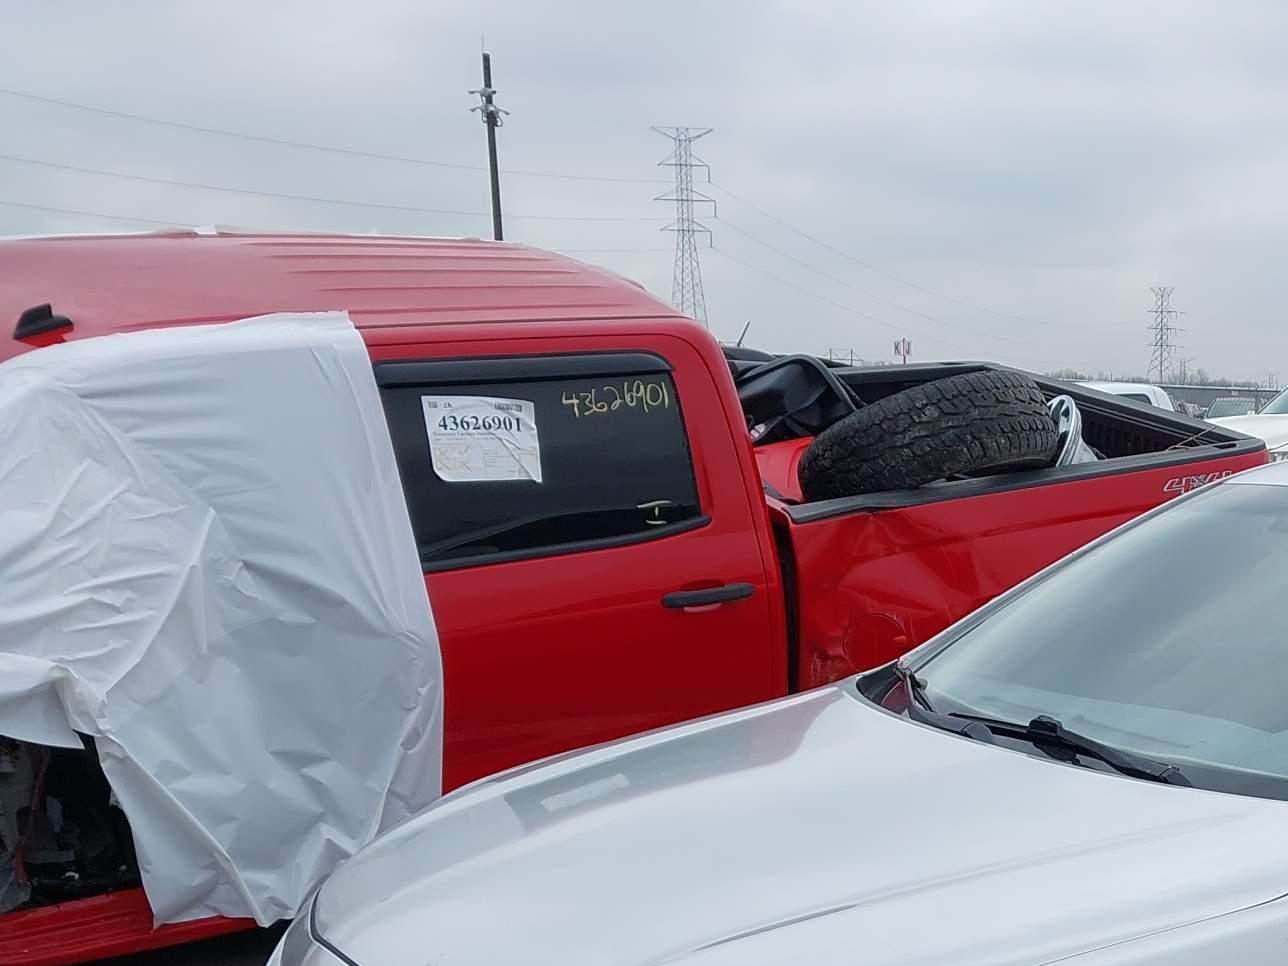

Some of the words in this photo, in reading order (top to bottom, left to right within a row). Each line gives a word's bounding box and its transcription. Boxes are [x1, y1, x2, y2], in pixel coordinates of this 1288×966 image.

[894, 341, 901, 355] K
[562, 381, 669, 417] 43626901
[438, 415, 522, 432] 43626901
